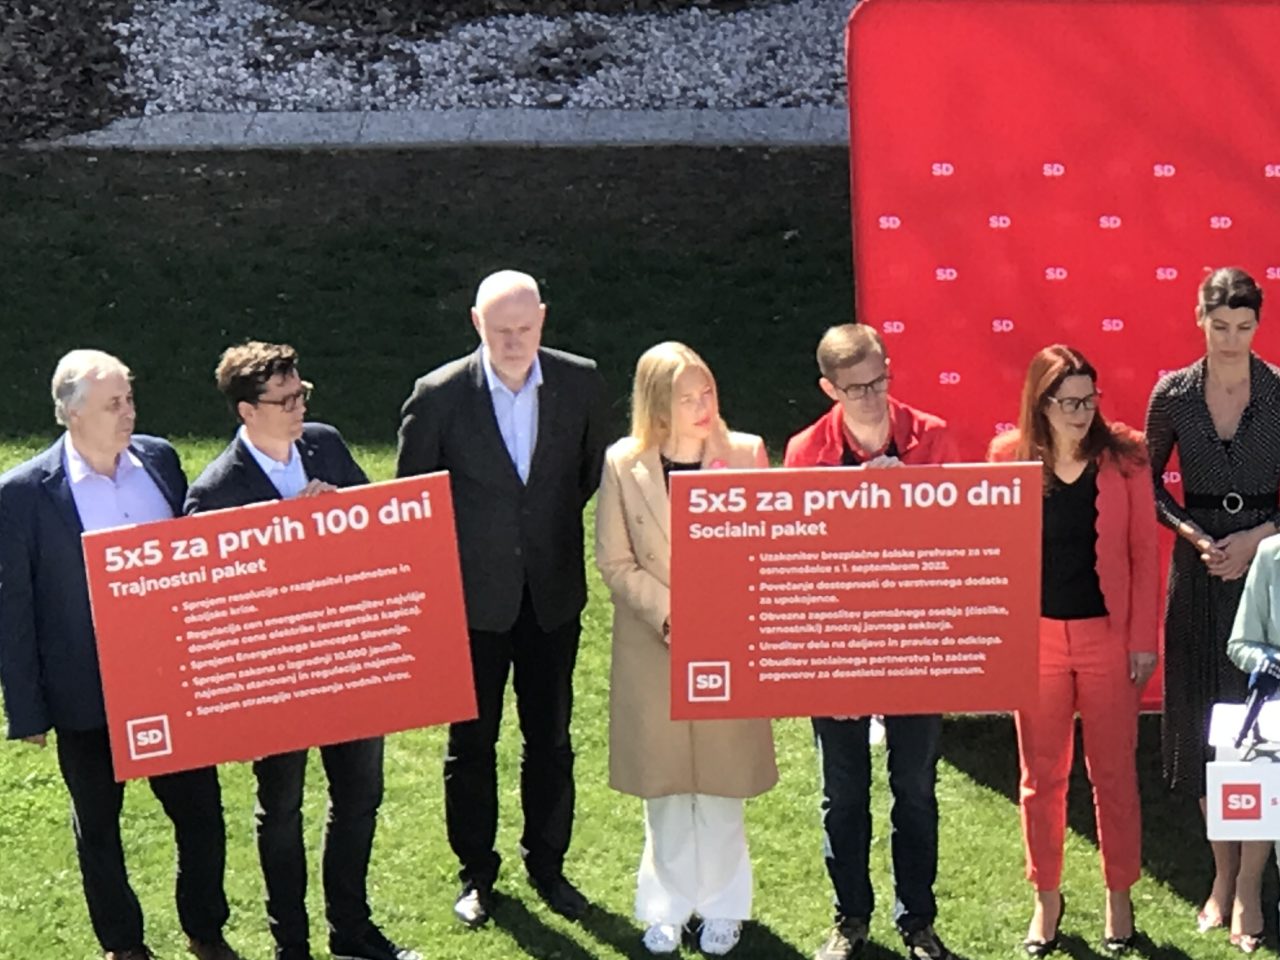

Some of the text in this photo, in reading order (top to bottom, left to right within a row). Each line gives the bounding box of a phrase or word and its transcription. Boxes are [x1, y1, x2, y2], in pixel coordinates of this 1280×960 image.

[932, 163, 954, 176] SD
[1043, 164, 1064, 176] SD
[1154, 165, 1175, 177] SD
[879, 216, 901, 229] SD
[989, 216, 1011, 228] SD
[1100, 216, 1121, 228] SD
[1211, 216, 1232, 228] SD
[936, 269, 957, 280] SD
[1046, 268, 1067, 280] SD
[1156, 268, 1177, 280] SD
[883, 321, 904, 333] SD
[993, 320, 1013, 332] SD
[1103, 319, 1123, 331] SD
[940, 373, 960, 384] SD
[688, 477, 1020, 516] 5x5 za prvih 100 dni
[105, 490, 431, 571] 5x5 za prvih 100 dni
[689, 520, 826, 539] Socialni paket
[108, 558, 267, 596] Trajnostni paket
[696, 674, 722, 688] SD
[136, 729, 162, 745] SD
[1228, 794, 1256, 809] SD
